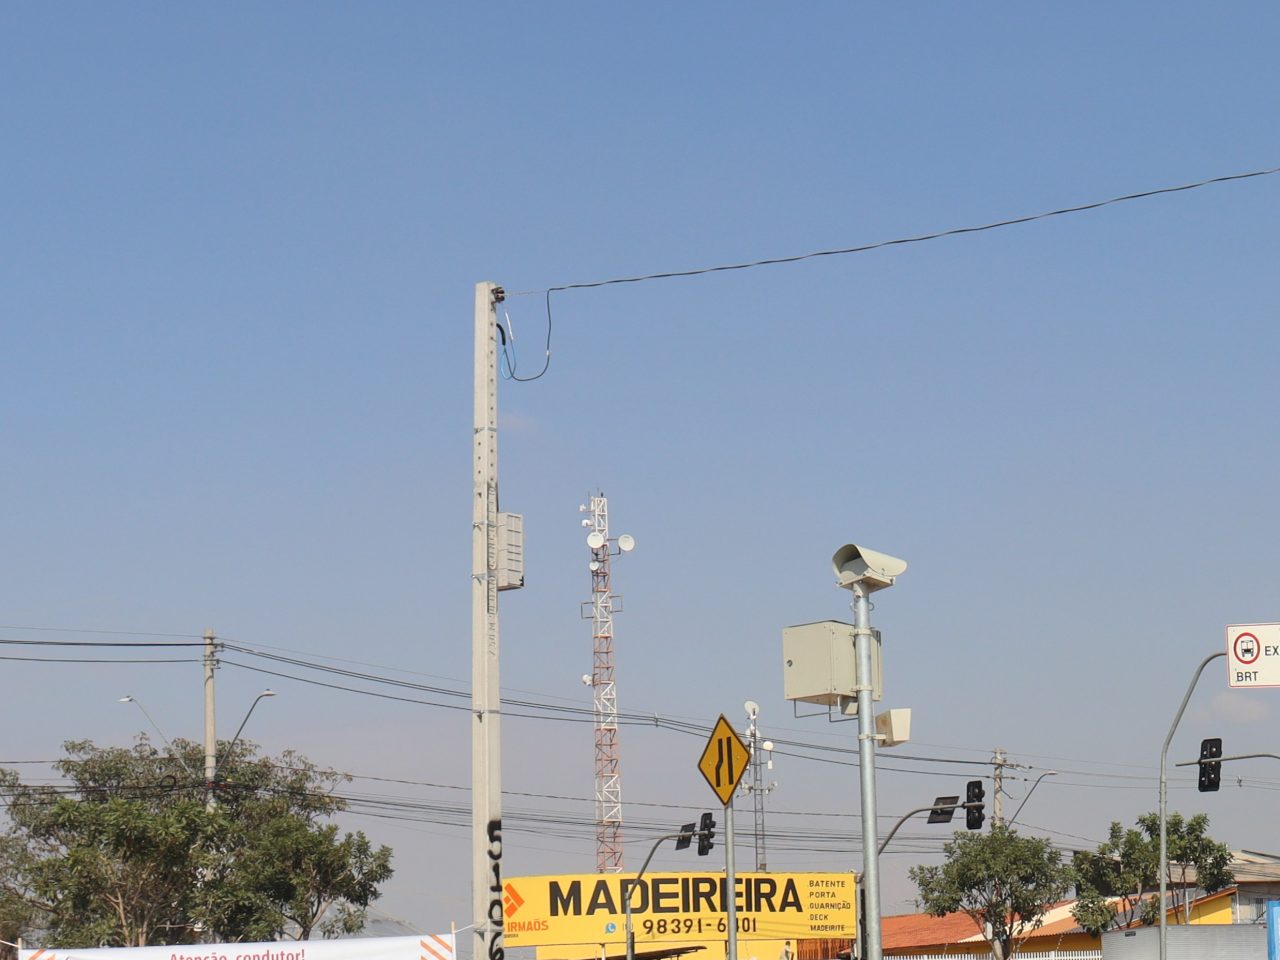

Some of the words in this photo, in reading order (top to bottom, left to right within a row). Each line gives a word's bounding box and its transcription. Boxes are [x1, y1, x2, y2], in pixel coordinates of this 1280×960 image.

[1236, 671, 1259, 682] BRT
[549, 877, 803, 917] MADEIREIRA
[643, 917, 757, 934] 98391-601
